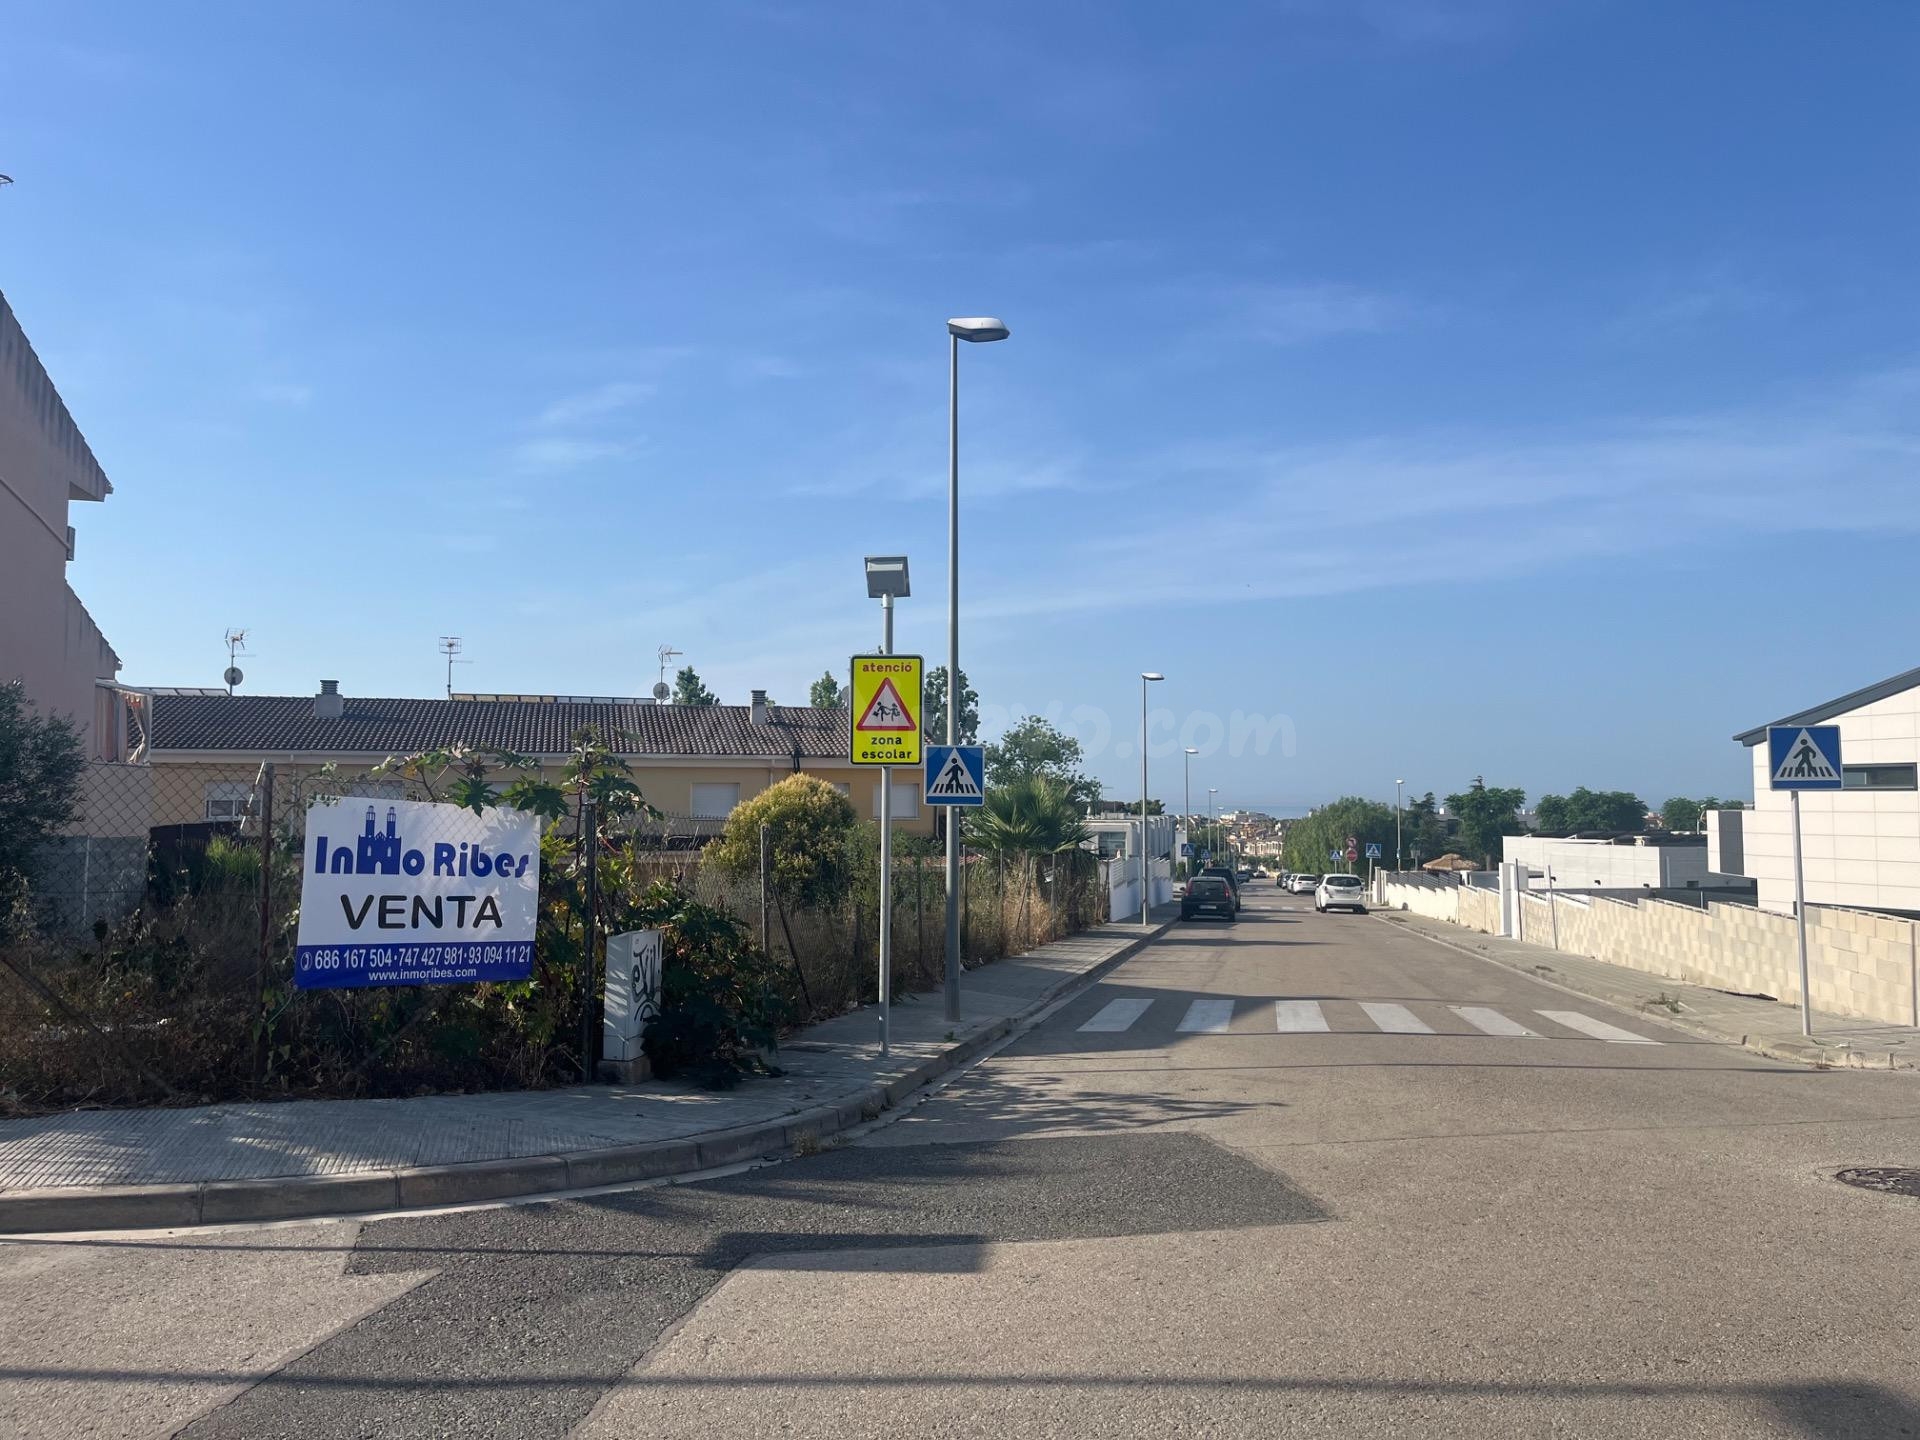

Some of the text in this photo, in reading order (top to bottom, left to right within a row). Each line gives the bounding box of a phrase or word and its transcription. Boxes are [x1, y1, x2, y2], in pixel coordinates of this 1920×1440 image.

[871, 736, 903, 745] zona
[861, 749, 912, 760] escolar
[433, 841, 530, 878] Ribes
[340, 894, 503, 931] VENTA
[314, 950, 340, 970] 686
[343, 949, 367, 969] 167
[368, 967, 477, 981] www.inmoribes.com
